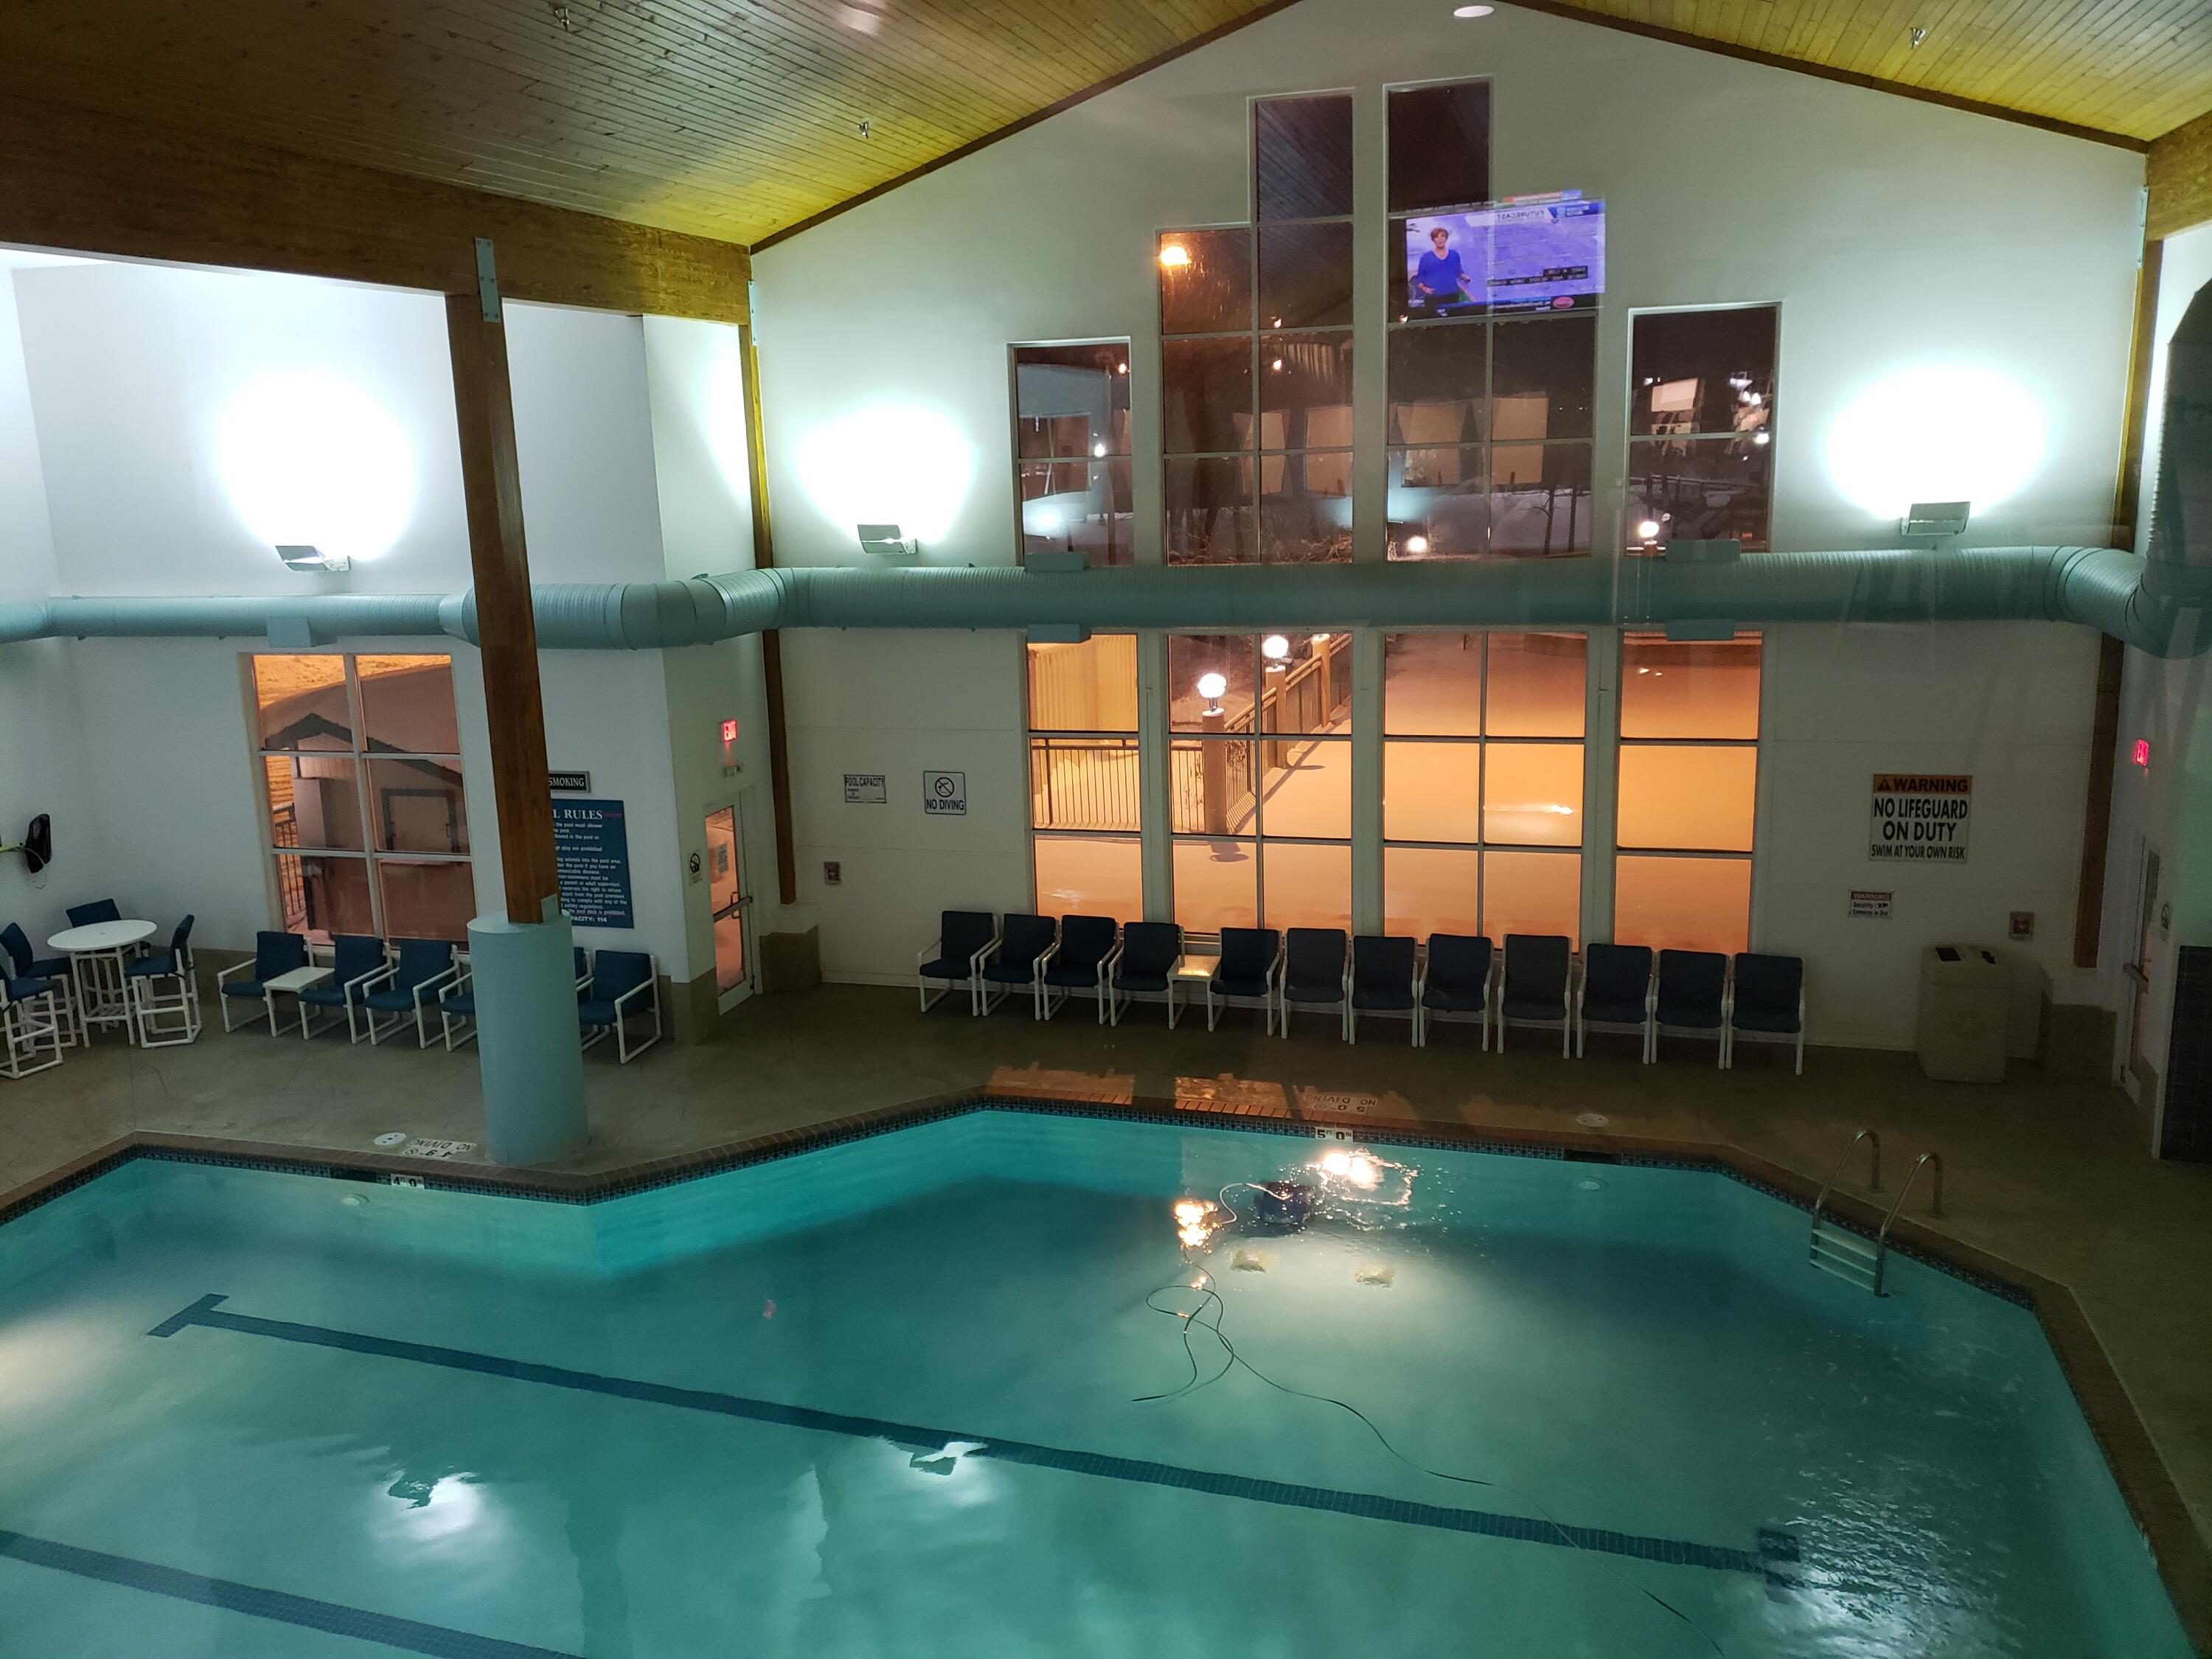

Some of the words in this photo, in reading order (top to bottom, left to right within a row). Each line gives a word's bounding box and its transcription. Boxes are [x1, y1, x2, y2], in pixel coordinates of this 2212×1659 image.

[549, 776, 585, 787] SMOKING
[844, 777, 859, 787] POOL
[859, 777, 885, 787] CAPACITY
[1893, 778, 1968, 792] WARNING
[926, 799, 937, 810] NO
[939, 799, 964, 810] DIVING
[1874, 798, 1895, 818] NO
[1898, 798, 1968, 819] LIFEGUARD
[564, 809, 603, 820] RULES
[1882, 821, 1909, 841] ON
[1913, 821, 1958, 842] DUTY
[1871, 844, 1893, 857] SWIM
[1893, 844, 1904, 858] AT
[1905, 845, 1926, 858] YOUR
[1927, 846, 1947, 859] OWN
[1948, 846, 1965, 860] RISK
[1306, 1094, 1351, 1104] DIVING
[1317, 1129, 1326, 1138] 5
[1336, 1131, 1345, 1140] 0
